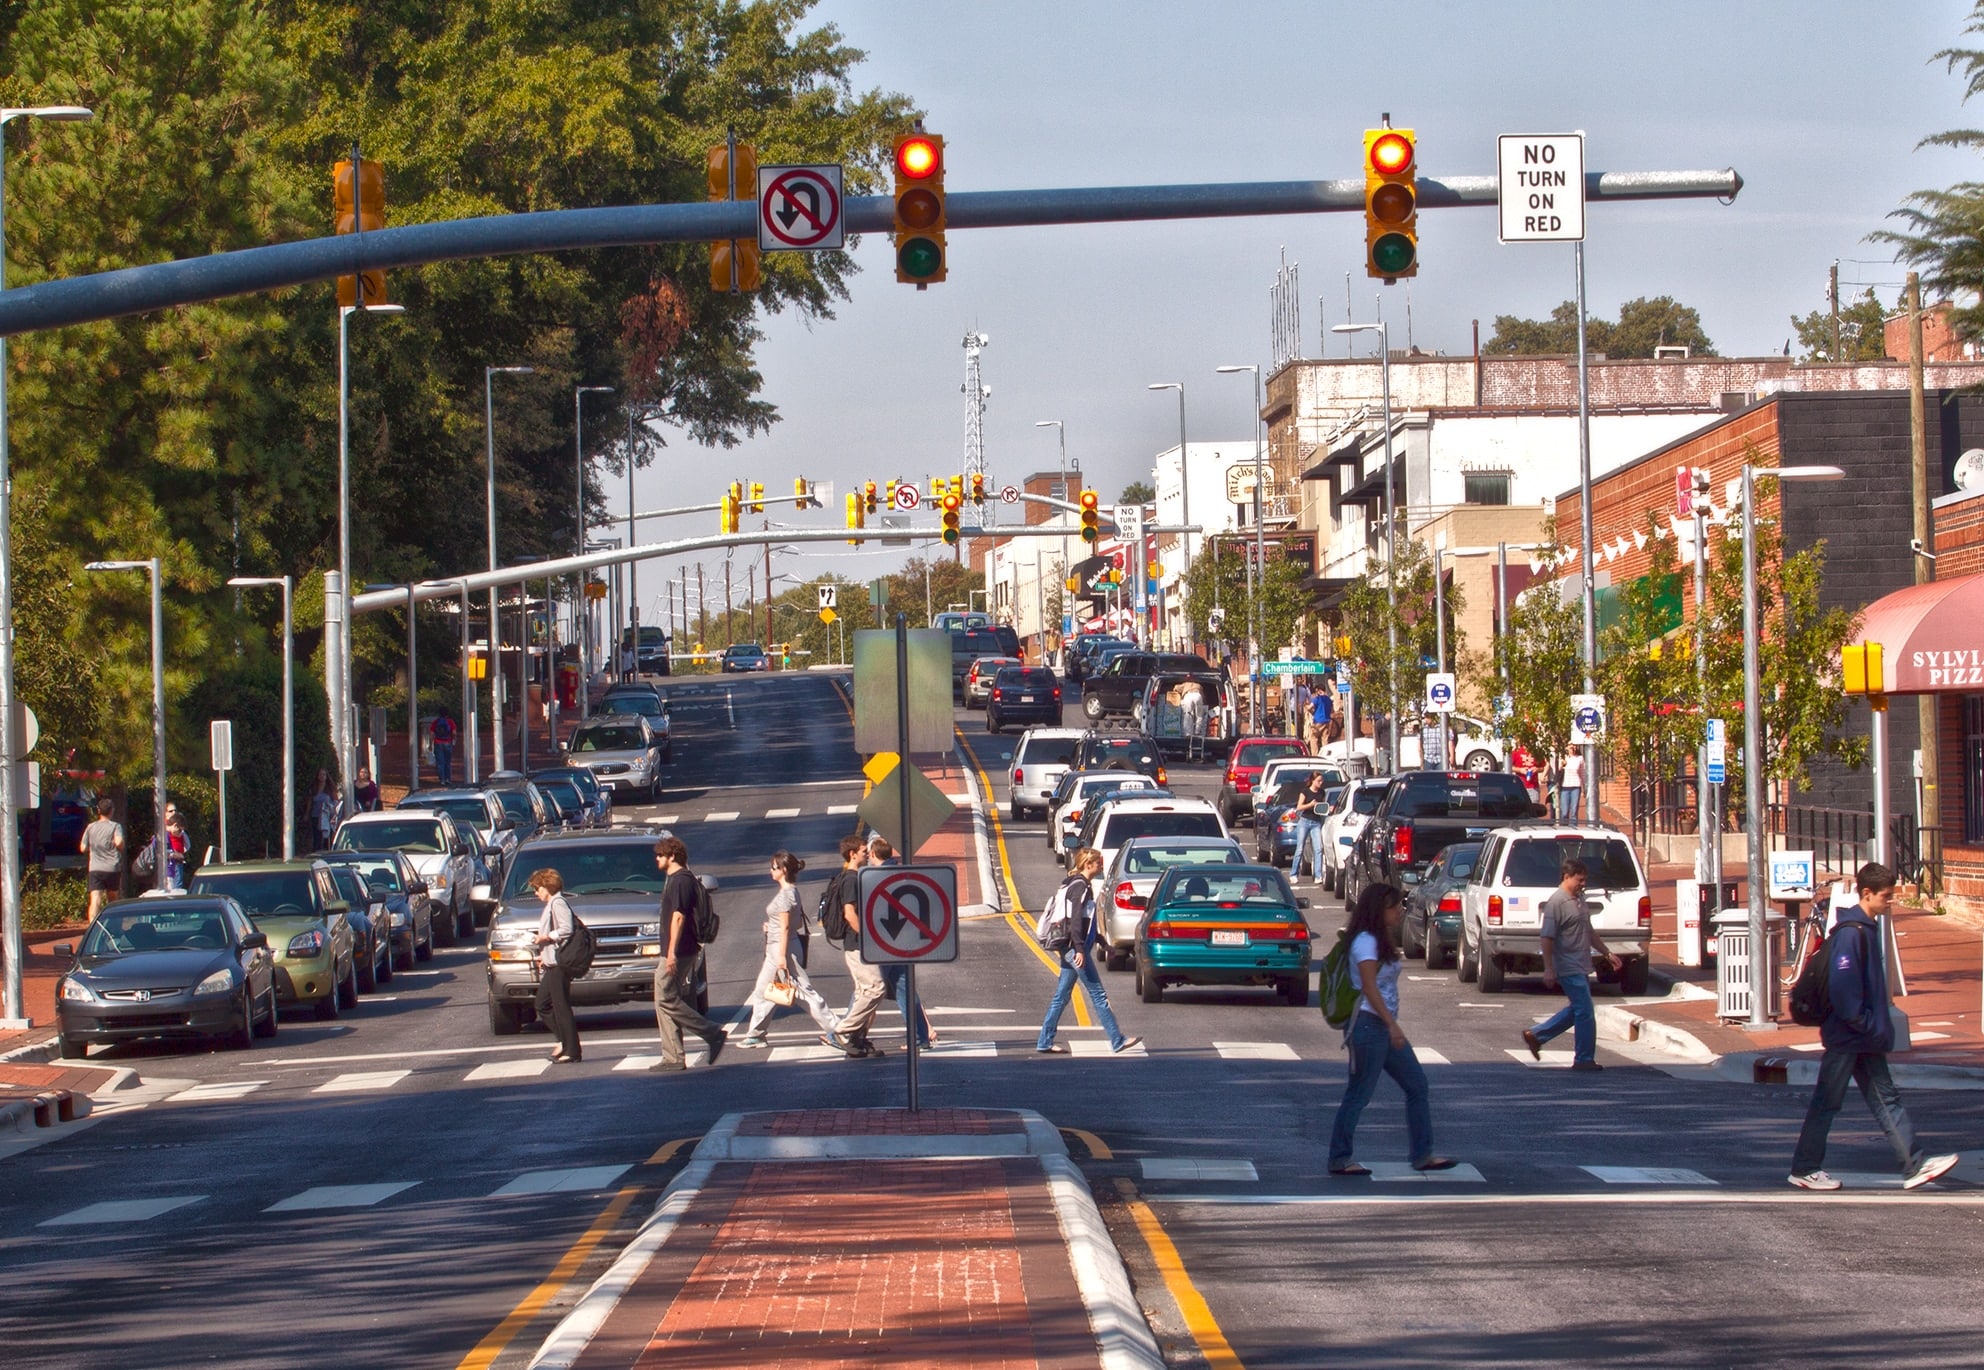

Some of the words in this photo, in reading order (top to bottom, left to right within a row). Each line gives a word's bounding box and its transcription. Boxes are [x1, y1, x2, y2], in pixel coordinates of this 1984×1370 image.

[1524, 144, 1556, 164] NO
[1517, 171, 1566, 187] TURN
[1528, 193, 1554, 209] ON
[1524, 215, 1562, 232] RED
[1913, 649, 1984, 668] SYLVI
[1265, 663, 1316, 673] Chamberlain
[1929, 667, 1983, 685] PIZZ
